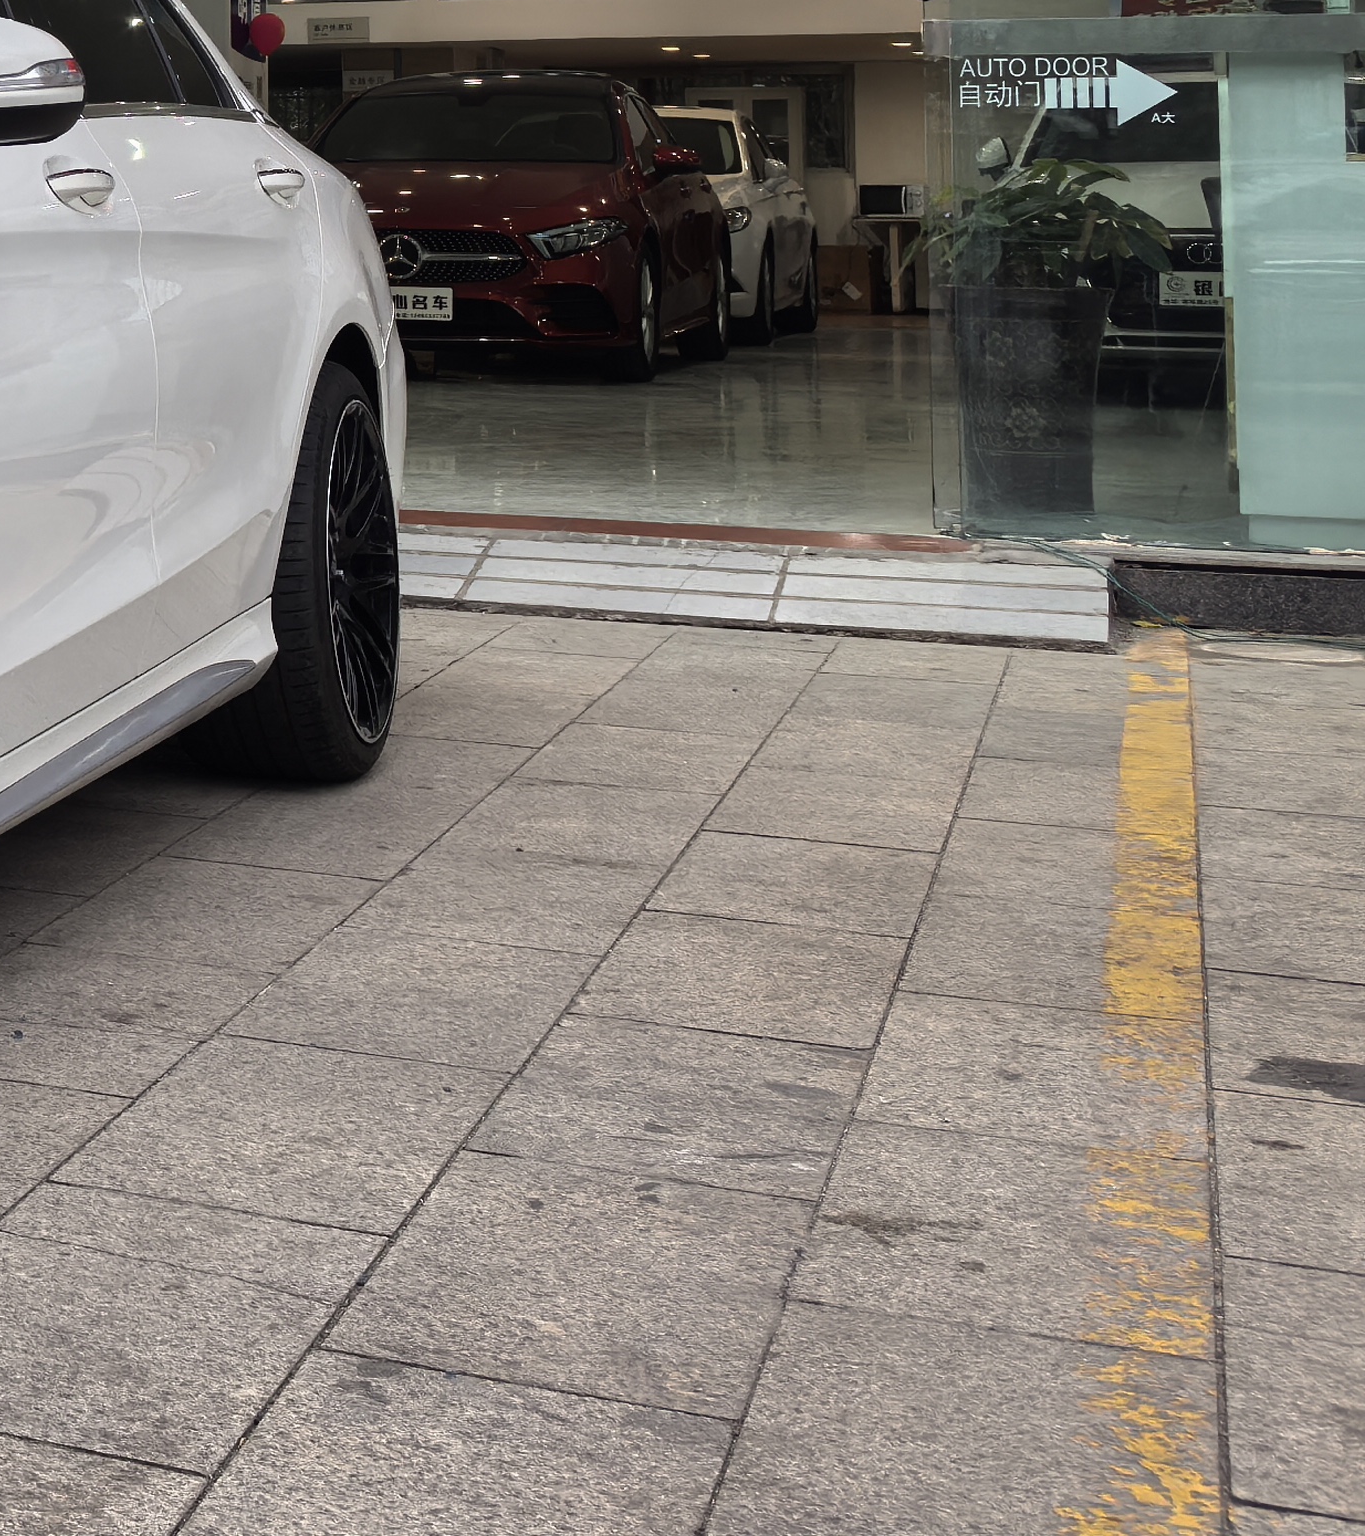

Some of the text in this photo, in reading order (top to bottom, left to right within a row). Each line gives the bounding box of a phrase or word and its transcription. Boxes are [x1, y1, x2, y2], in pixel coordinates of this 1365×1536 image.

[959, 56, 1108, 77] AUTO DOOR
[959, 79, 1041, 108] 自动门
